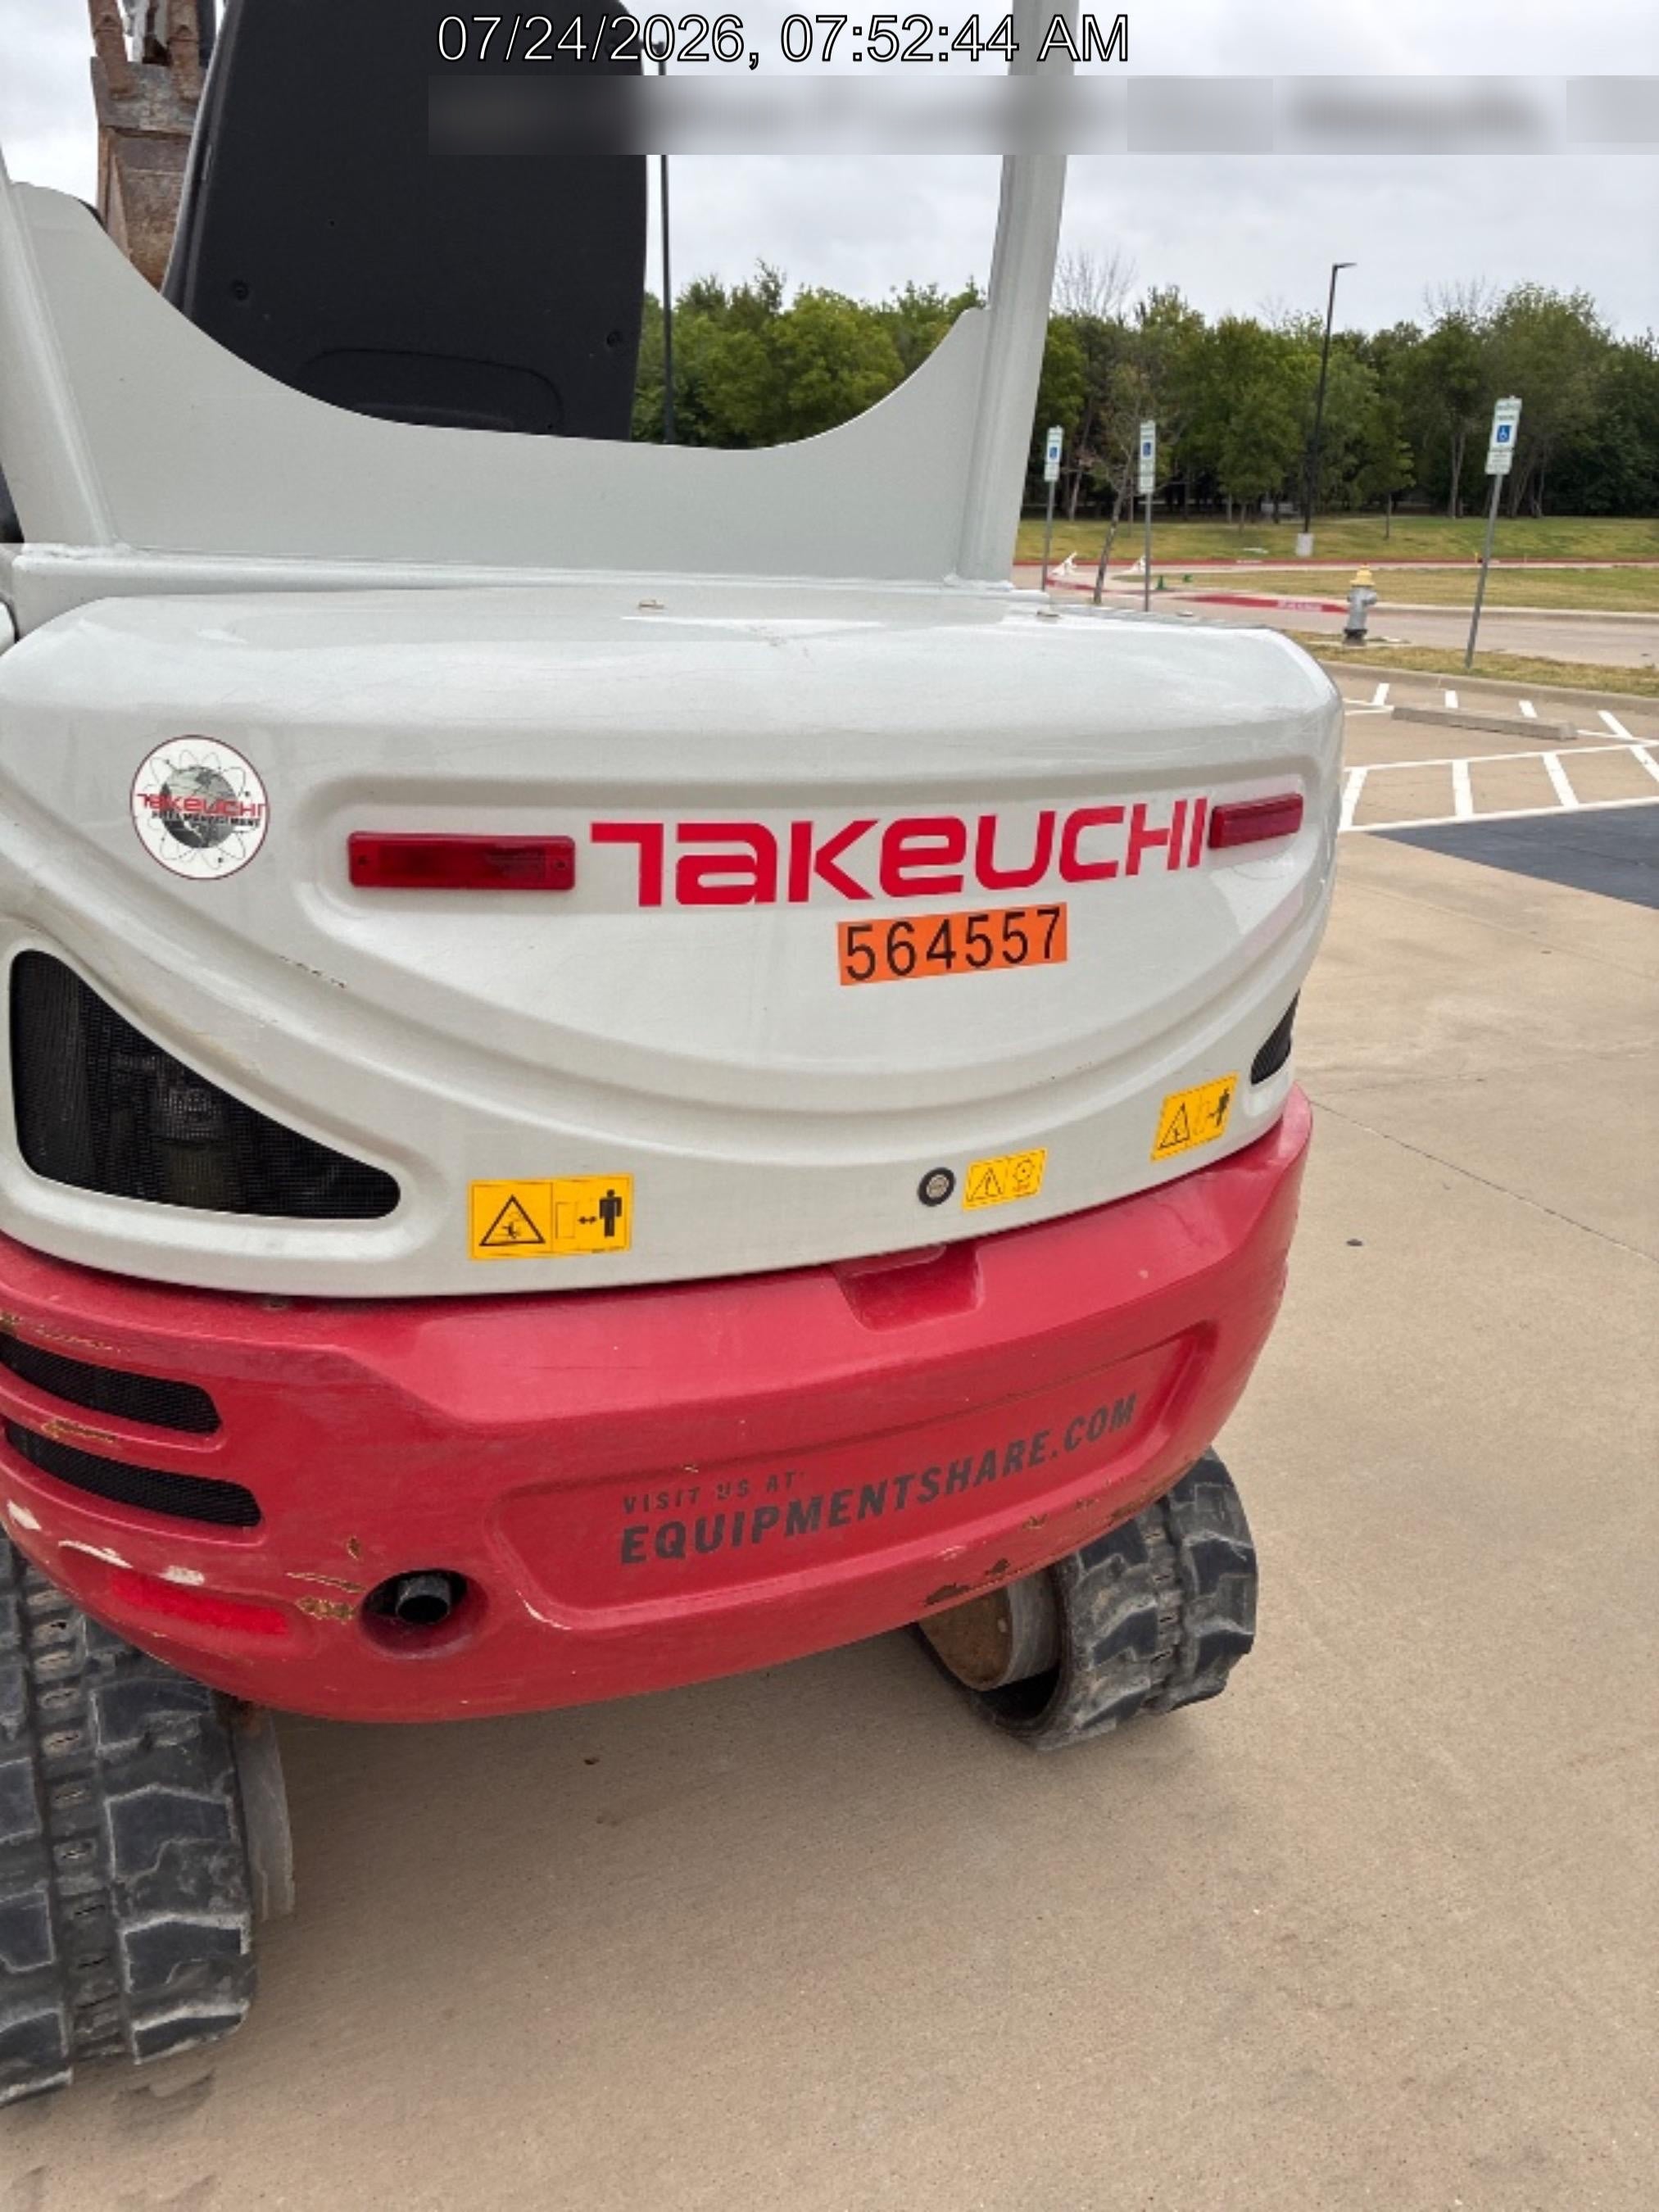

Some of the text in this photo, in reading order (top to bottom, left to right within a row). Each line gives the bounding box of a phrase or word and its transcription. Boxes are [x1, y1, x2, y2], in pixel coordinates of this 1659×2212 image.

[591, 797, 1208, 907] TAKEUCHI
[845, 908, 1062, 981] 564557
[620, 1392, 1137, 1565] EQUIPMENTSHARE.COM
[623, 1486, 700, 1514] VISIT
[716, 1478, 749, 1500] US
